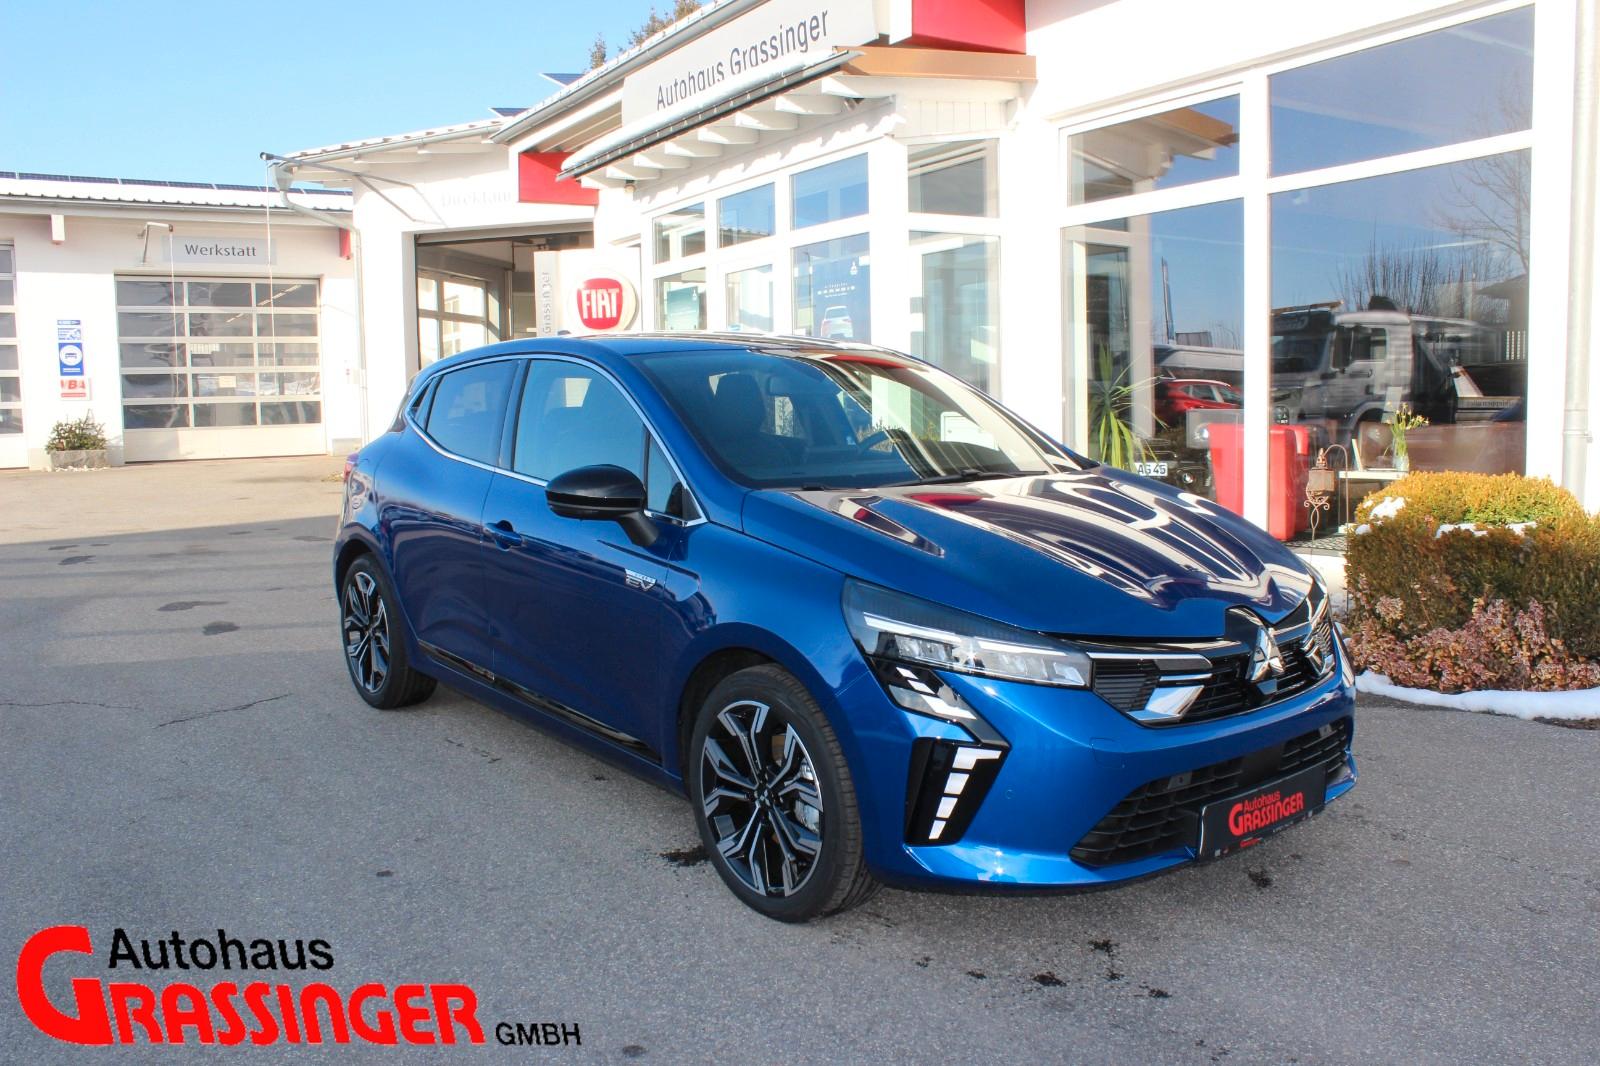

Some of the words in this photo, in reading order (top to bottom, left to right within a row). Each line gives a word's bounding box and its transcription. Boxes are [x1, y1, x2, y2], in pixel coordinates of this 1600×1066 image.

[656, 60, 726, 112] Autohaus
[729, 9, 828, 76] Grassinger
[184, 243, 257, 257] Werkstatt
[541, 271, 553, 335] Grassinger
[580, 287, 620, 321] FIAT
[1243, 790, 1281, 813] Autohaus
